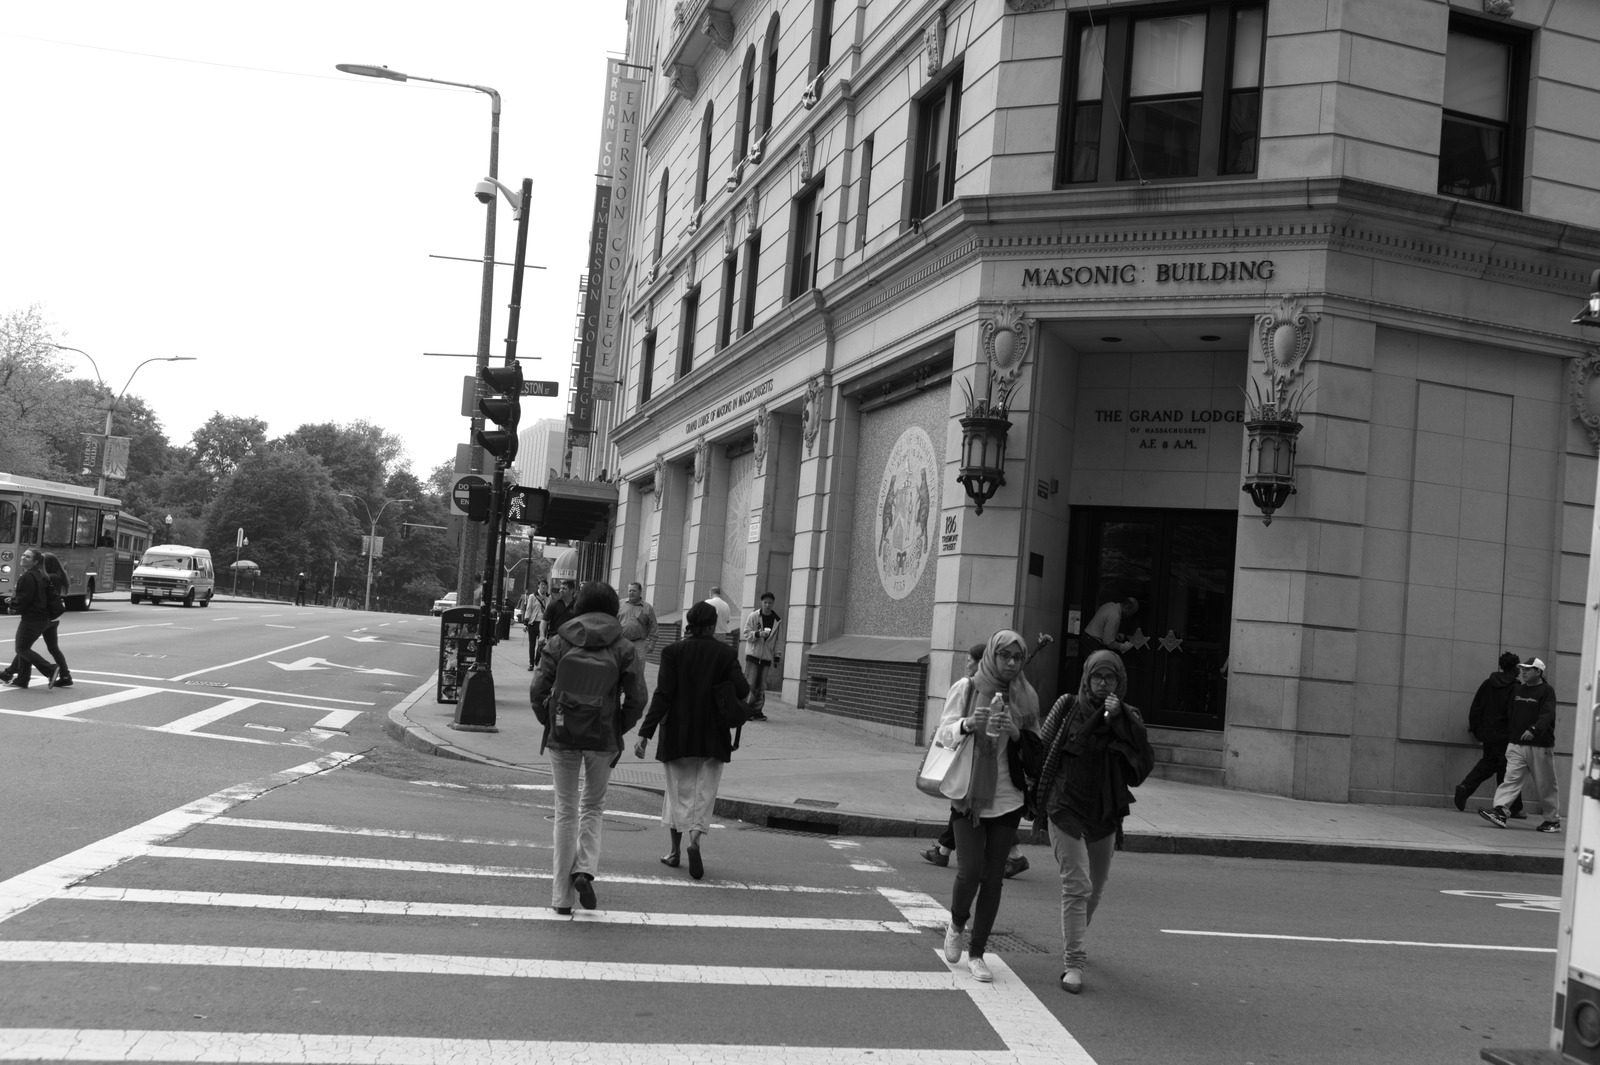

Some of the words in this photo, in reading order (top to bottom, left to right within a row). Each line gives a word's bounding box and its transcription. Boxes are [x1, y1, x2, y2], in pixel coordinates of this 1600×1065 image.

[606, 63, 620, 130] URBAN
[613, 91, 636, 220] EMERSON
[590, 196, 609, 301] EMERSON
[1021, 264, 1136, 287] MASONIC
[1156, 259, 1274, 283] BUILDING
[602, 237, 622, 368] COLLEGE
[580, 314, 597, 420] COLLEGE
[710, 409, 716, 422] OF
[1095, 410, 1122, 422] THE
[1129, 410, 1184, 422] GRAND
[1191, 410, 1245, 423] LODGE
[1162, 441, 1169, 449] &
[945, 515, 957, 534] 186
